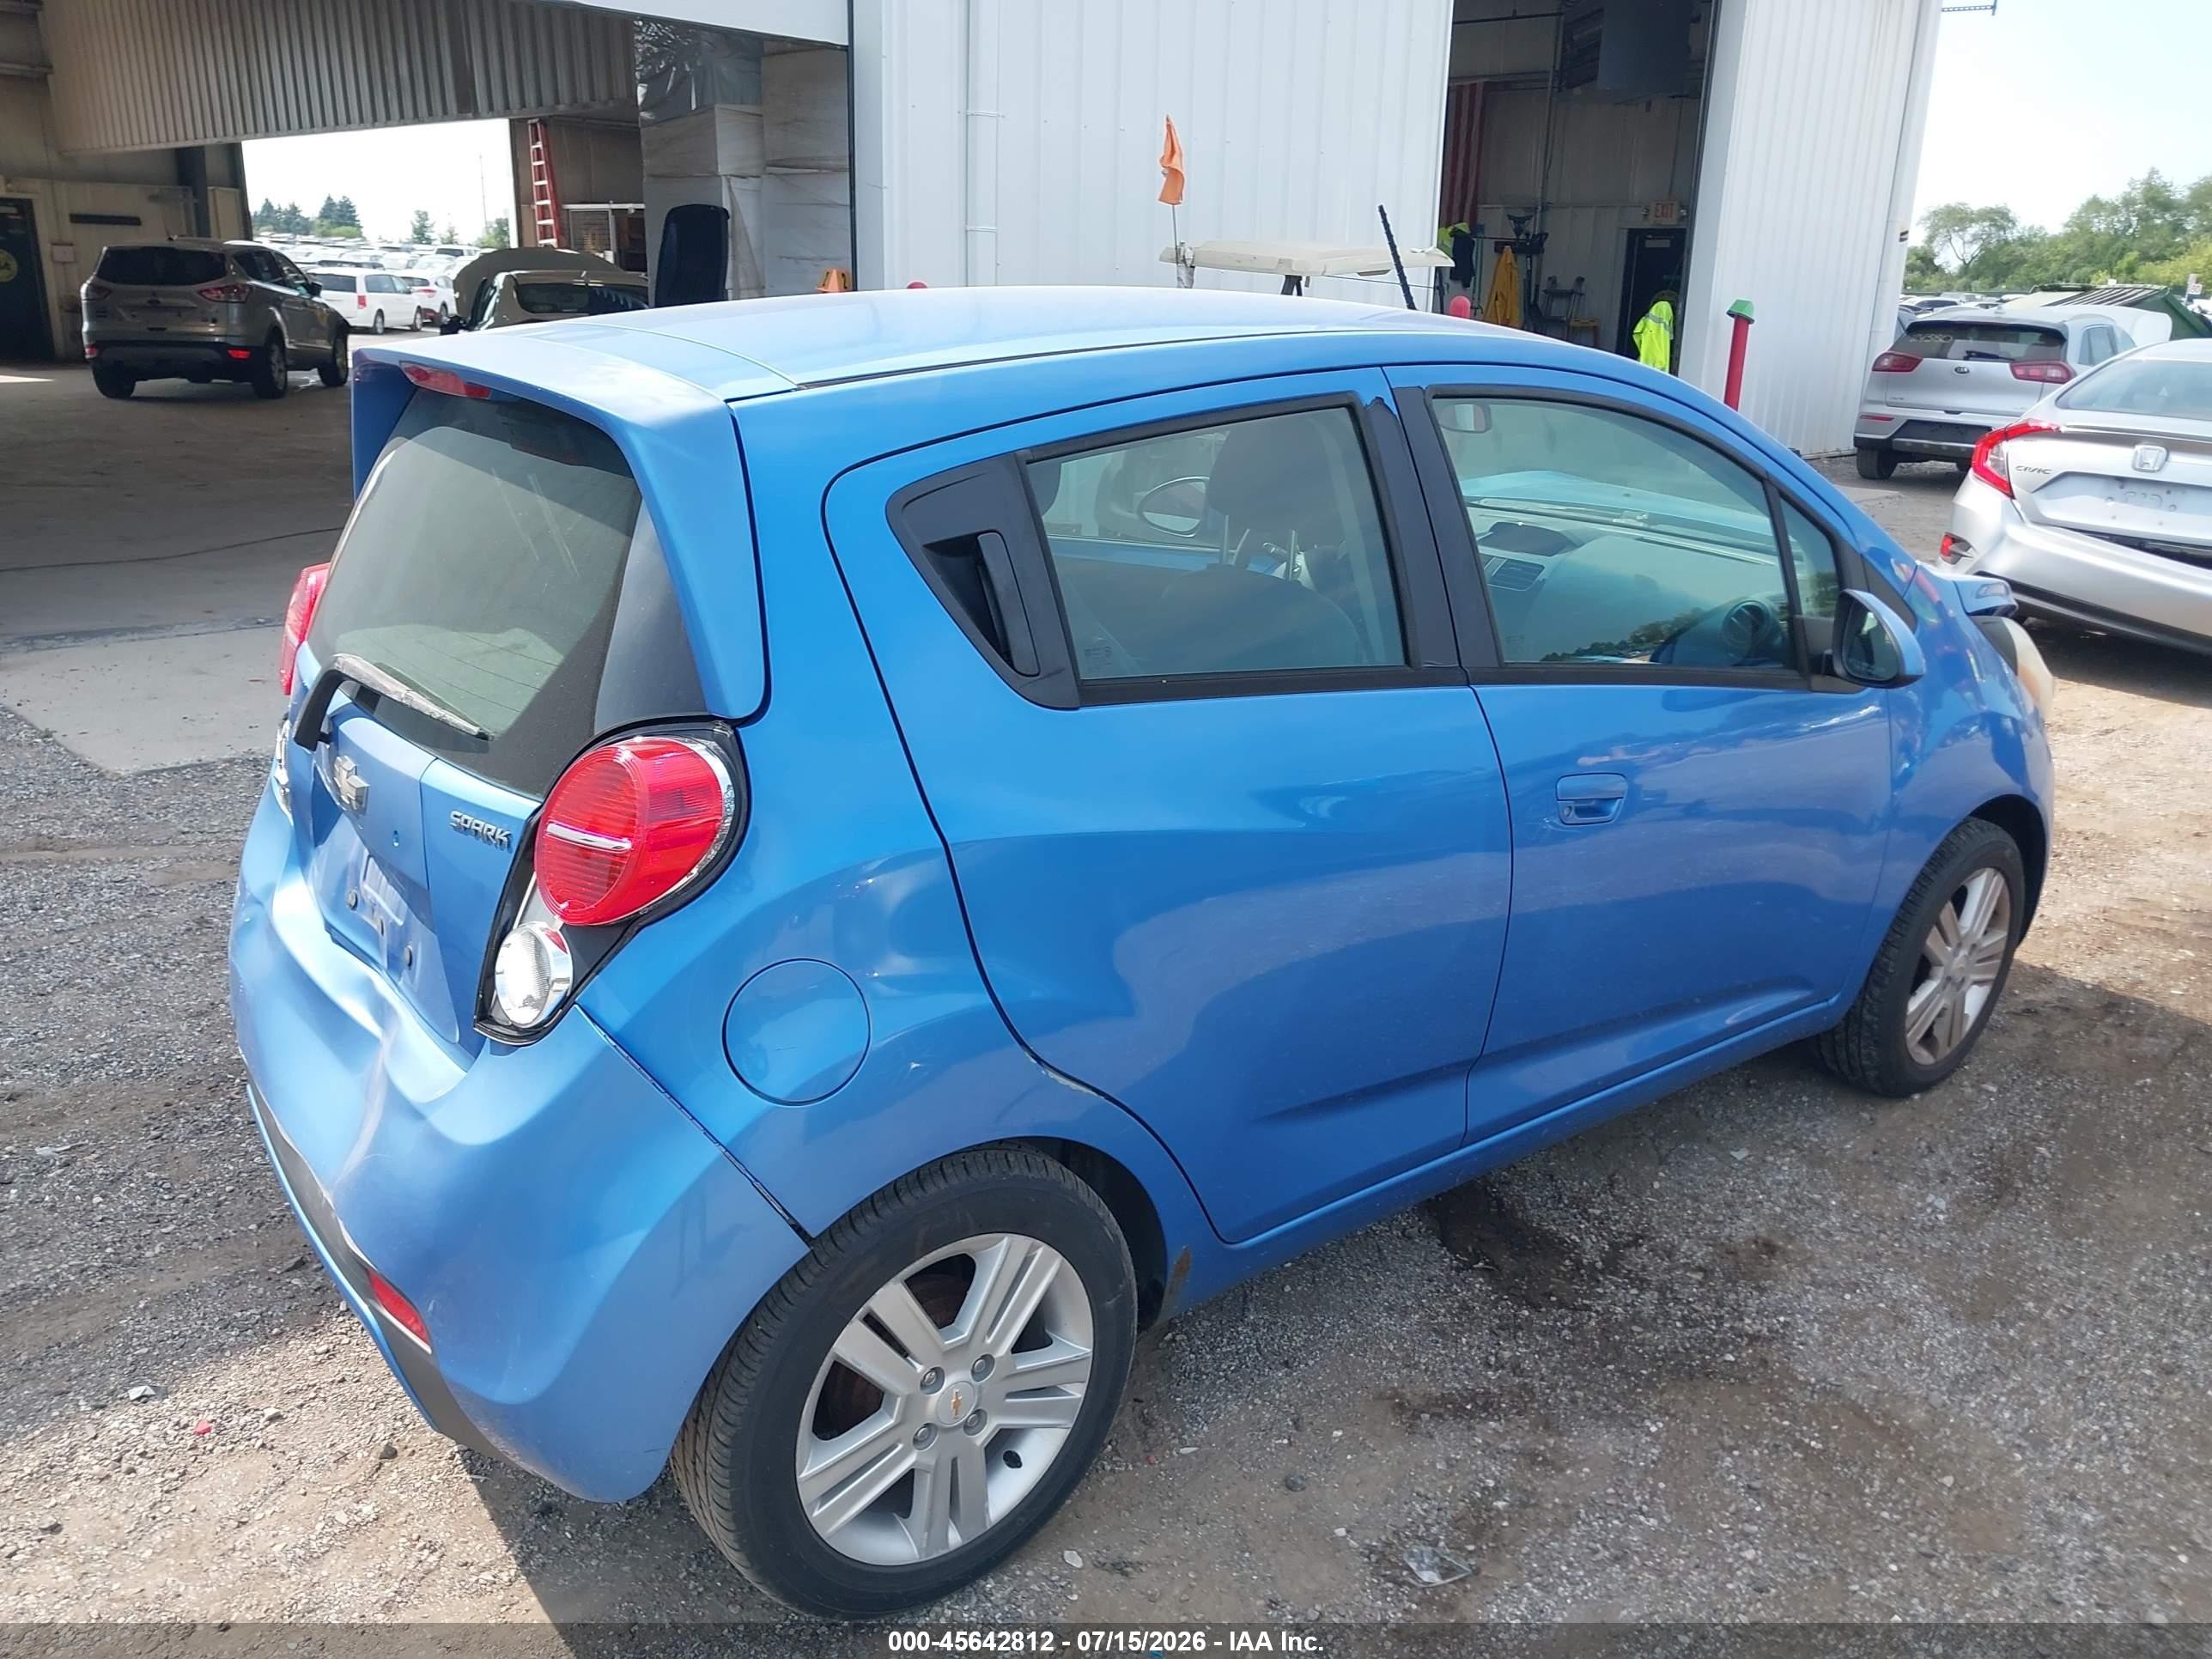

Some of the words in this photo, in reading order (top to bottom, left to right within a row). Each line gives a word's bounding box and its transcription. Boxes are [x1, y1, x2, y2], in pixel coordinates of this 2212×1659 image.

[1656, 203, 1674, 218] EXIT
[2015, 465, 2053, 475] CIVIC
[449, 810, 513, 848] SPARK
